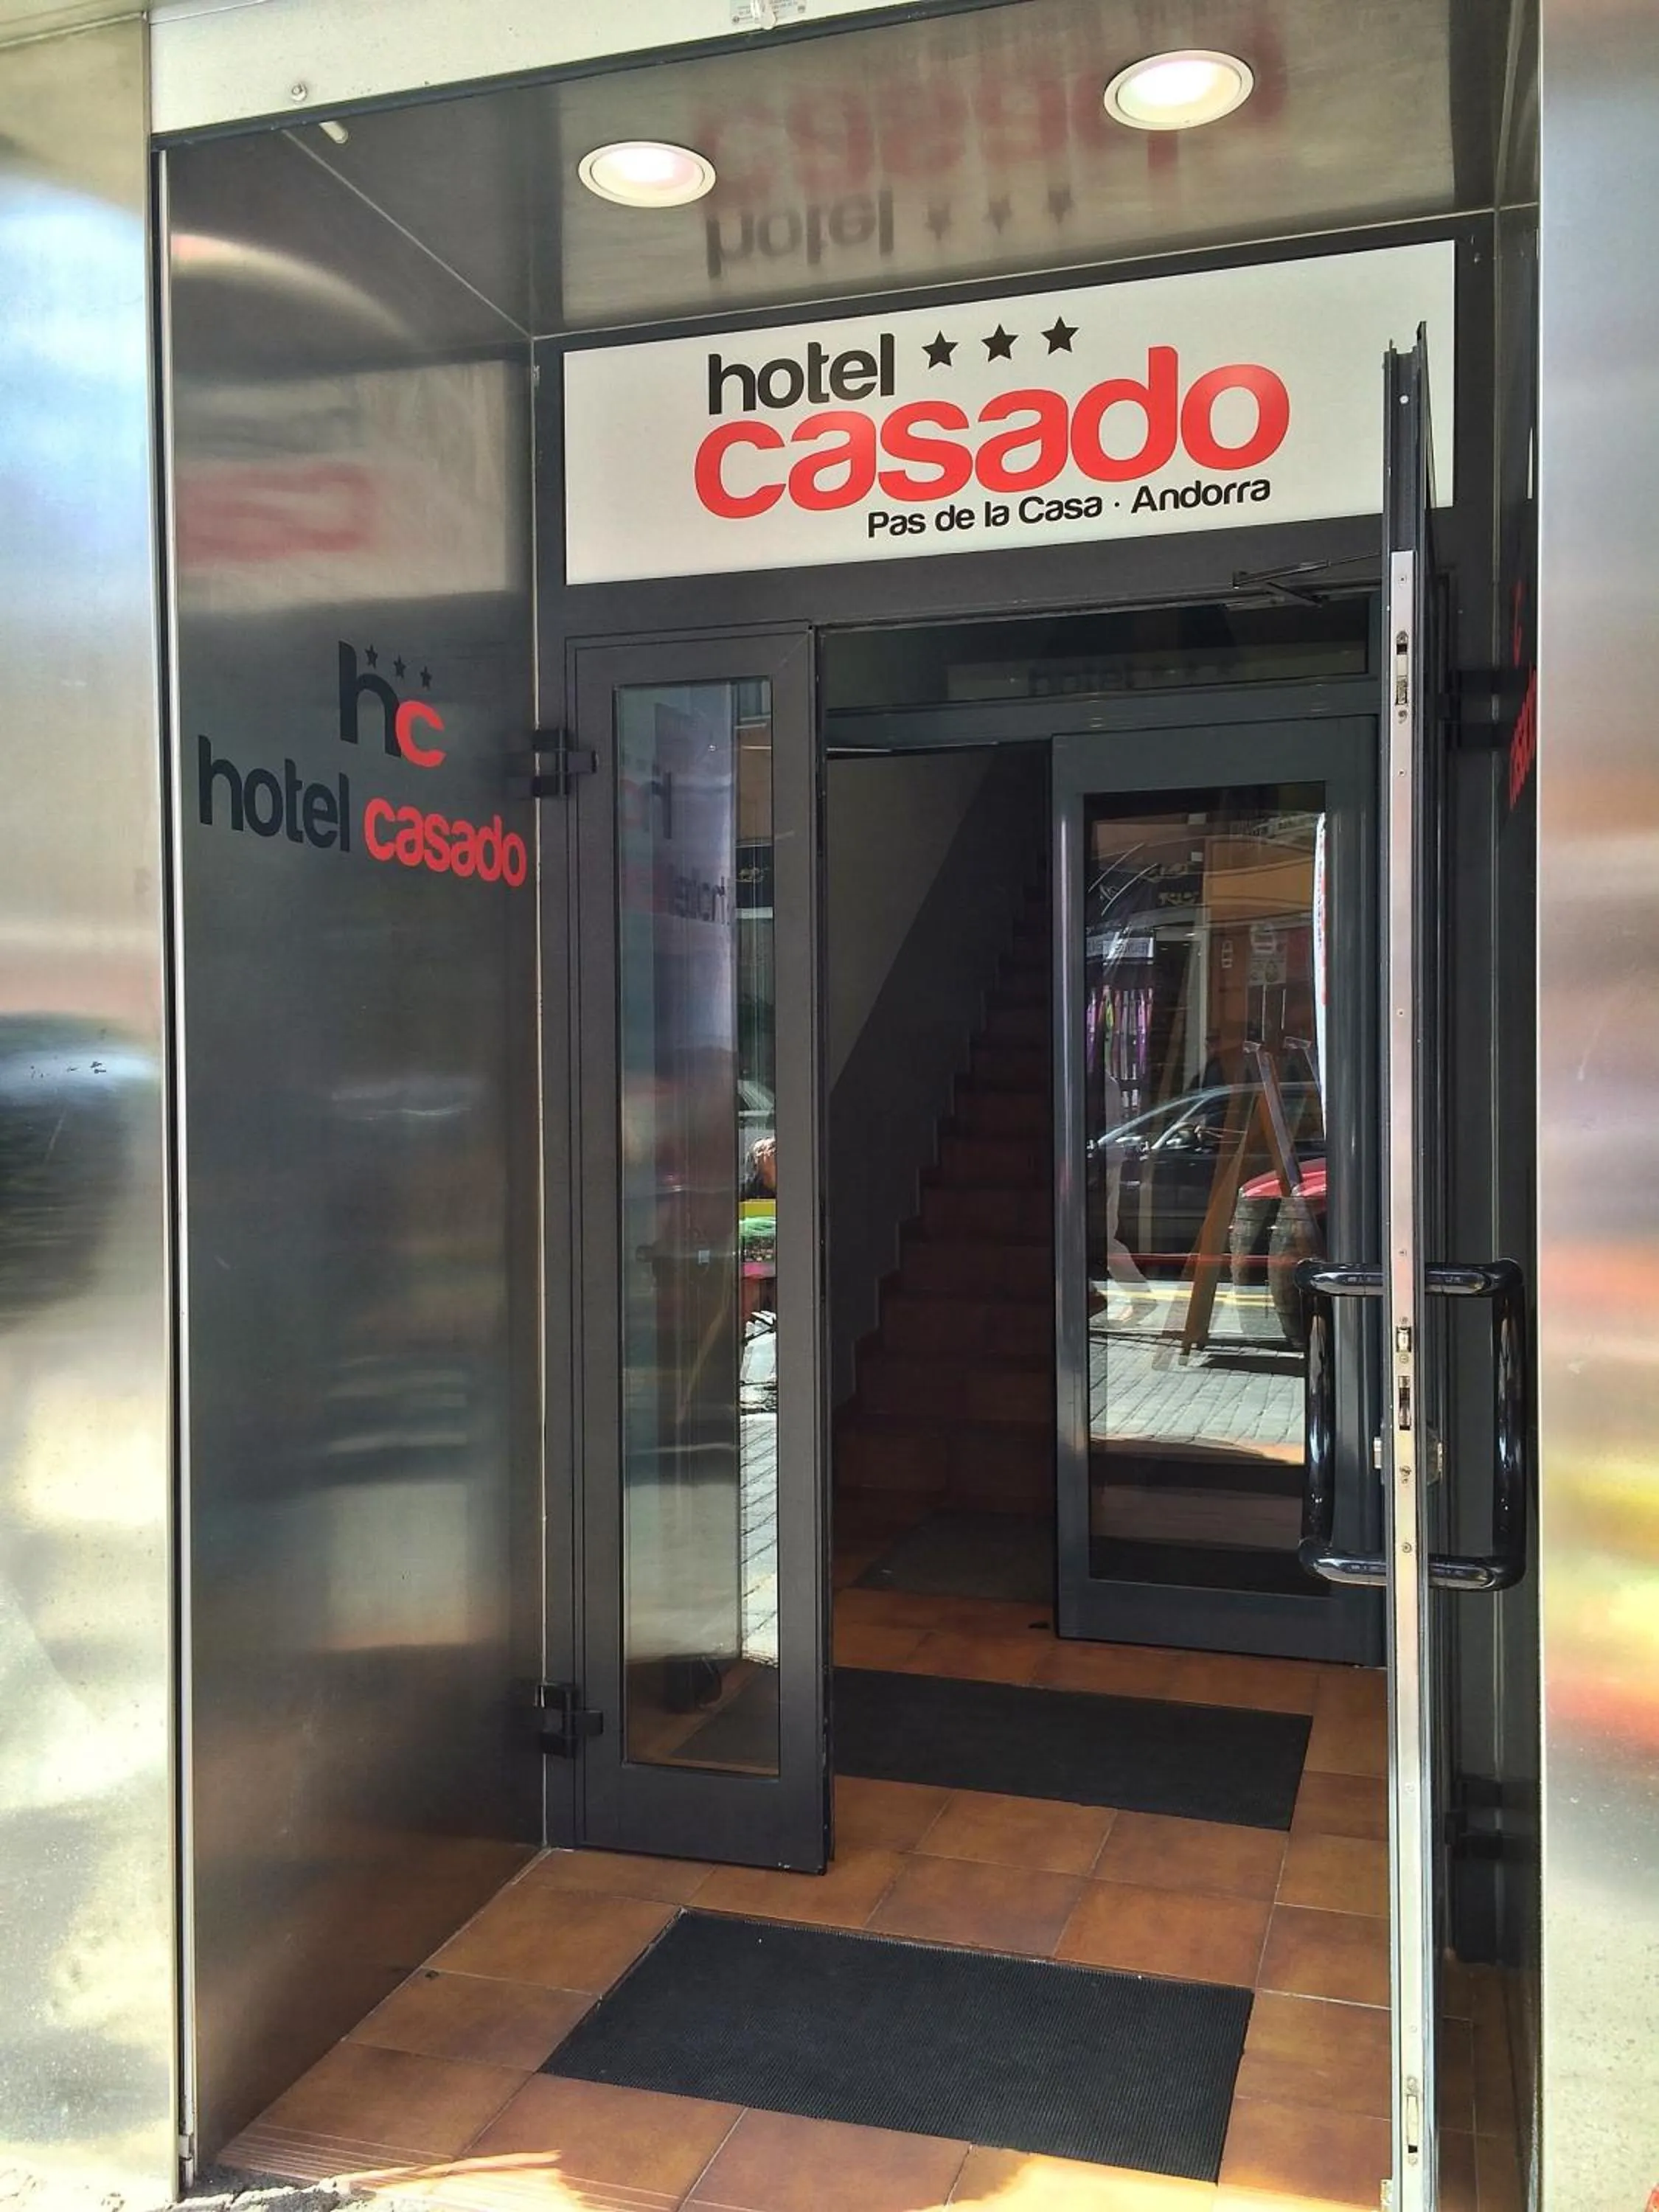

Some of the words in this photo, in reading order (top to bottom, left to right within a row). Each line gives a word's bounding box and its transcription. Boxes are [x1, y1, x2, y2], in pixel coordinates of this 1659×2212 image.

[708, 333, 895, 414] hotel
[693, 346, 1290, 519] casado
[868, 511, 926, 538] Pas
[934, 504, 975, 532] de
[984, 501, 1009, 527] la
[1018, 496, 1103, 524] Casa
[1130, 479, 1270, 514] Andorra
[198, 735, 350, 852] hotel
[364, 798, 527, 887] casado
